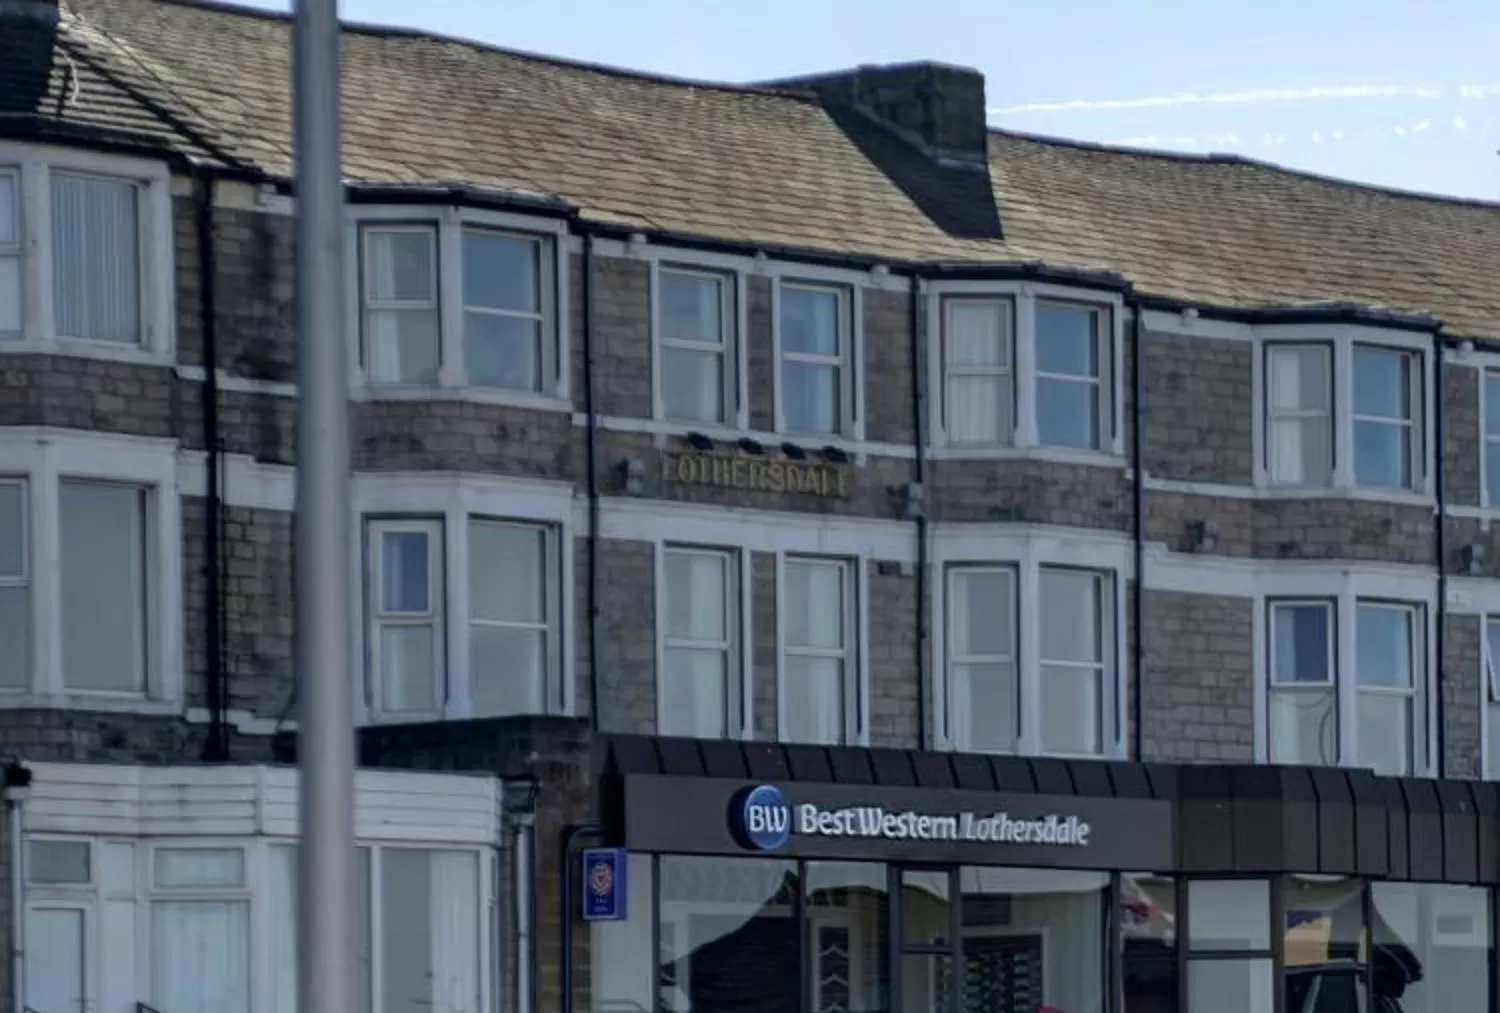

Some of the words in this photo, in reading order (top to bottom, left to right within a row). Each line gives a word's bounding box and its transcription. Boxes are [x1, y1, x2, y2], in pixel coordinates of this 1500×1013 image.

[749, 804, 786, 833] BW
[799, 803, 856, 835] Best
[857, 807, 958, 840] Western
[963, 811, 1090, 845] Lothersdale
